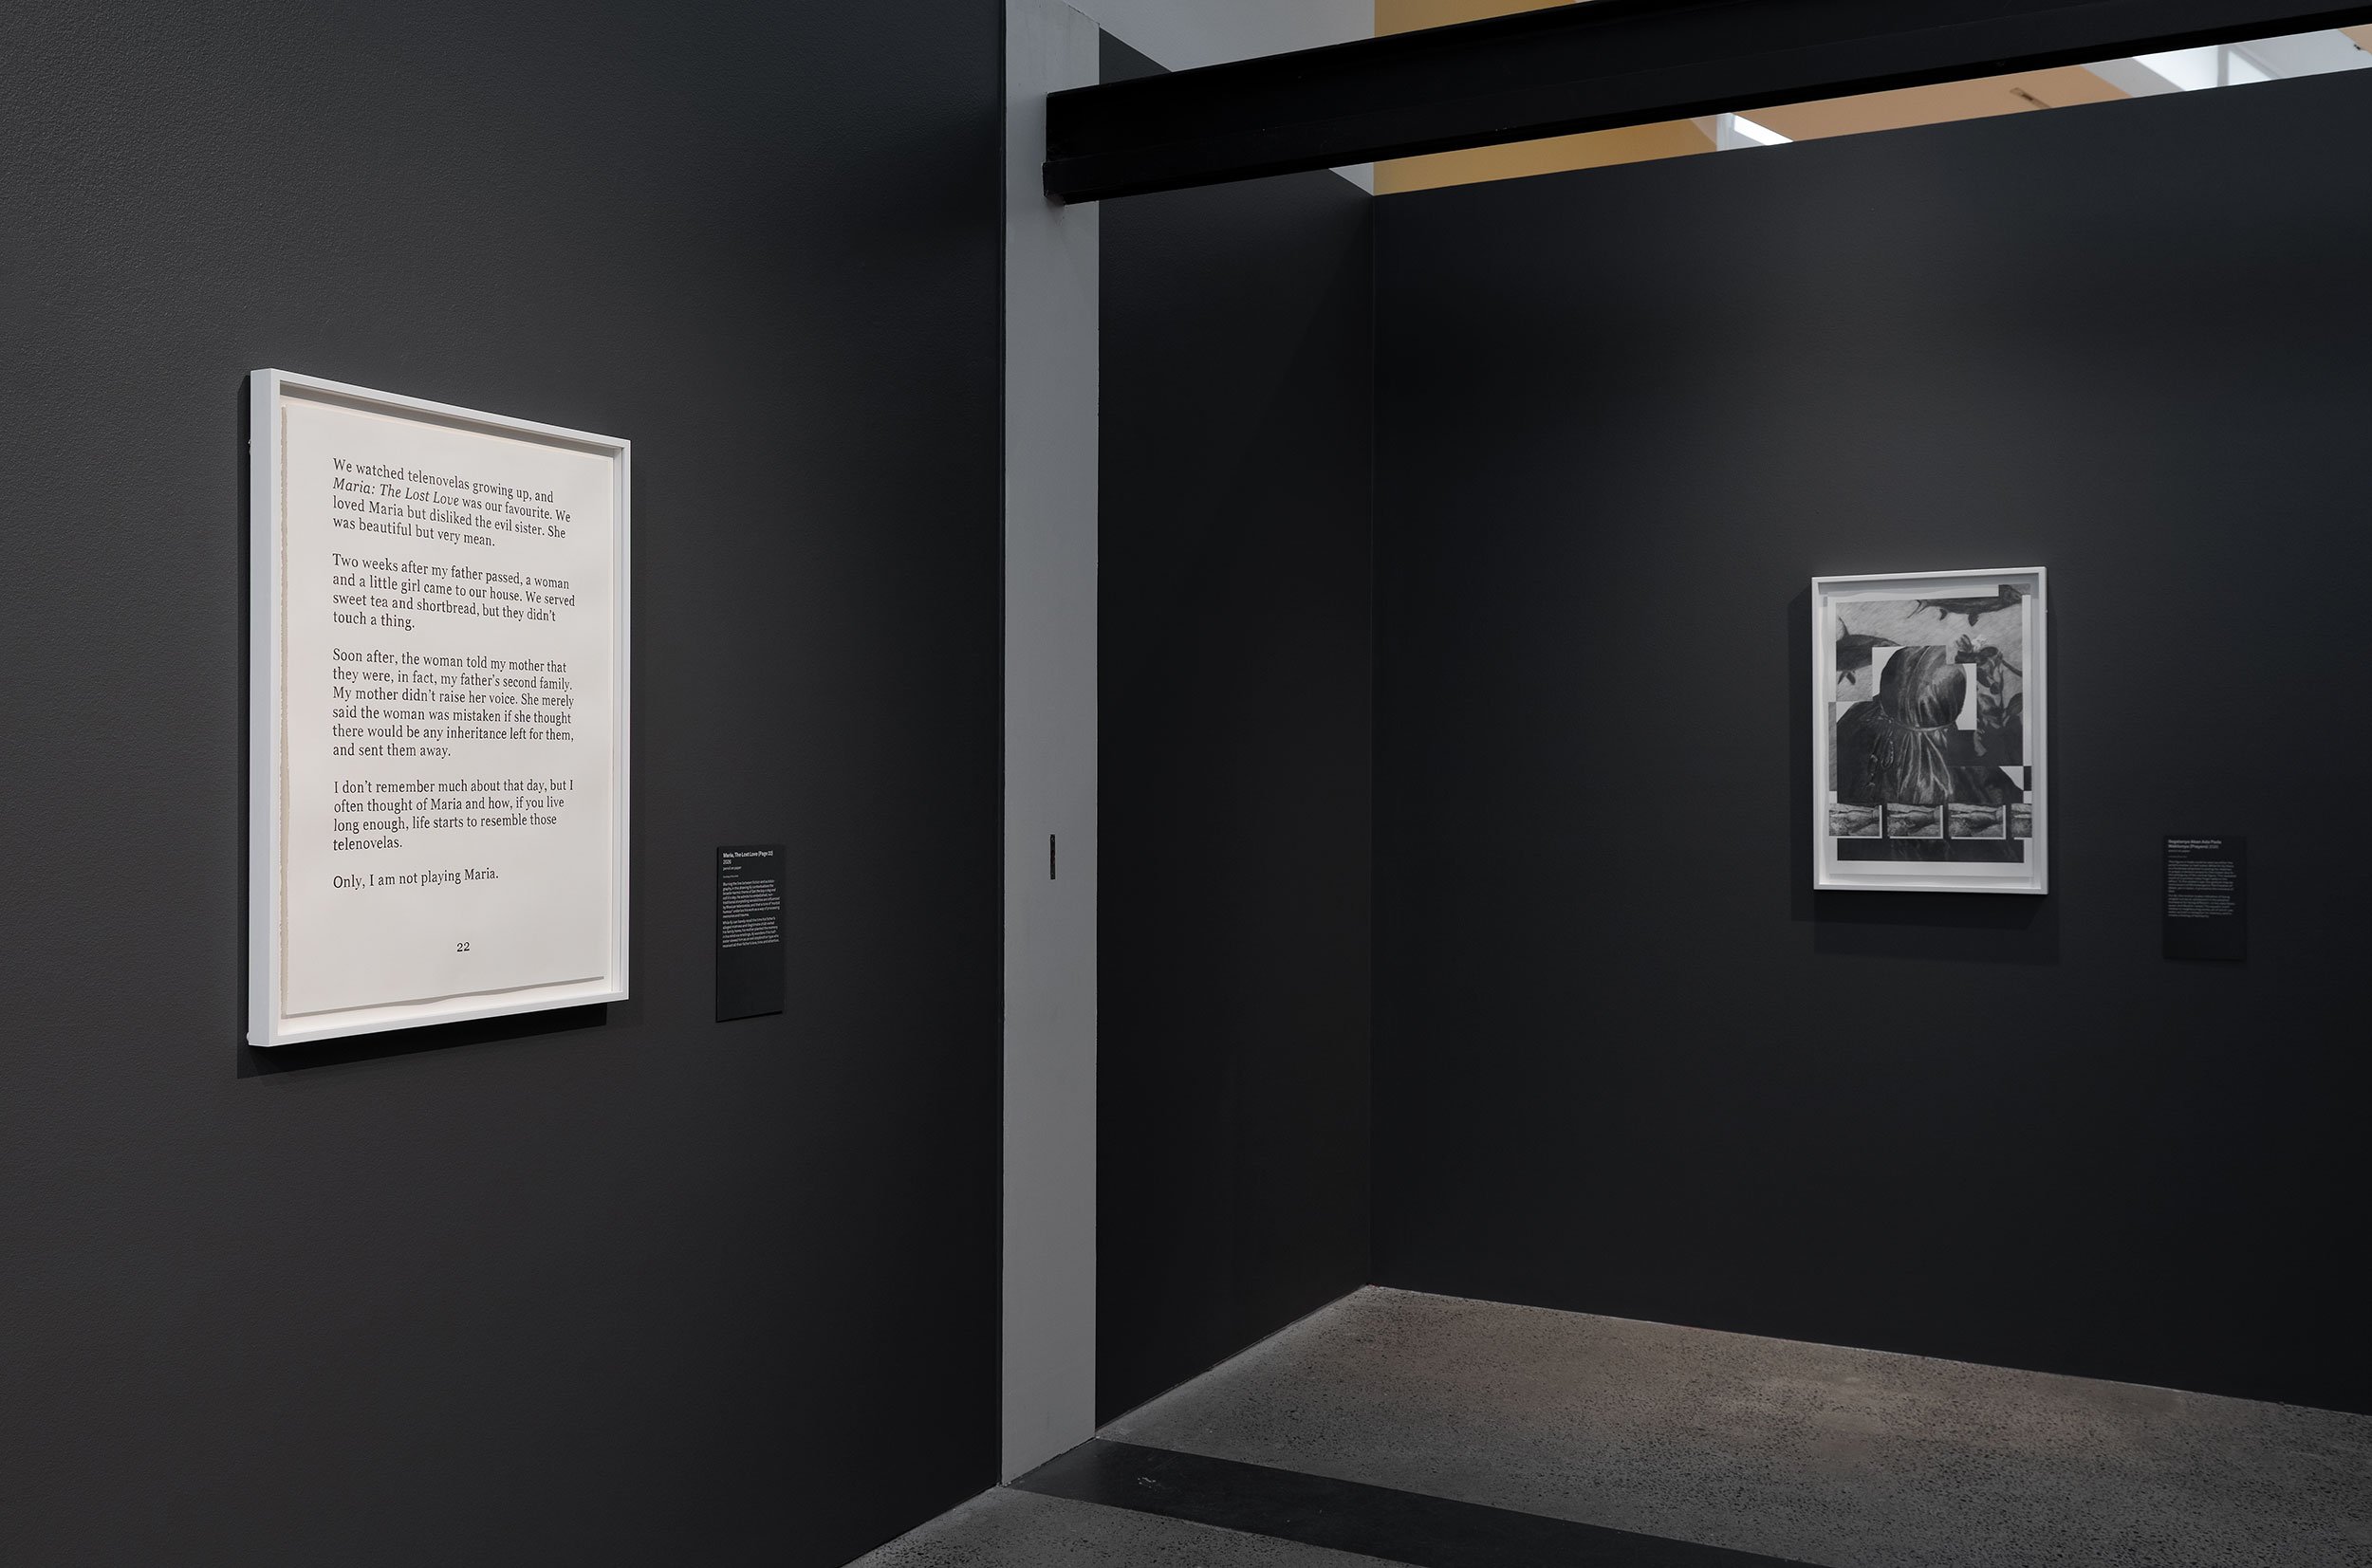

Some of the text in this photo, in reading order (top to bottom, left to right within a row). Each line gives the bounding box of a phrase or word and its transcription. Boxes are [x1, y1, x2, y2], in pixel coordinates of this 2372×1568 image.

[333, 457, 553, 503] We watched telenovelas growing up, and
[332, 477, 570, 523] Maria: The Lost Love was our favourite. We
[333, 495, 565, 539] loved Maria but disliked the evil sister. She
[333, 517, 495, 546] was beautiful but very mean.
[332, 553, 569, 589] Two weeks after my father passed, a woman
[333, 573, 575, 606] and a little girl came to our house. We served
[333, 594, 367, 606] sweet
[370, 595, 388, 608] tea
[392, 597, 414, 610] and
[417, 598, 479, 617] shortbread,
[482, 603, 499, 617] but
[502, 605, 524, 622] they
[333, 611, 415, 631] touch a thing.
[333, 648, 566, 673] Soon after, the woman told my mother that
[332, 666, 359, 684] they
[362, 672, 394, 684] were,
[398, 670, 409, 683] in
[413, 670, 437, 686] fact,
[440, 675, 457, 688] my
[503, 676, 537, 689] second
[540, 676, 572, 692] family.
[333, 686, 352, 702] My
[355, 687, 398, 700] mother
[439, 691, 465, 703] raise
[469, 691, 487, 703] her
[489, 692, 518, 705] voice.
[521, 692, 539, 706] She
[542, 694, 574, 710] merely
[332, 705, 571, 727] said the woman was mistaken if she thought
[332, 723, 574, 742] there would be any inheritance left for them,
[333, 743, 451, 759] and sent them away.
[334, 781, 339, 793] I
[376, 779, 435, 793] remember
[438, 779, 468, 792] much
[471, 779, 500, 792] about
[503, 779, 524, 791] that
[527, 779, 547, 794] day,
[549, 779, 566, 791] but
[569, 780, 573, 790] I
[334, 795, 565, 815] often thought of Maria and how, if you live
[334, 813, 557, 835] long enough, life starts to resemble those
[333, 835, 402, 851] telenovelas.
[333, 867, 498, 891] Only, I am not playing Maria.
[456, 942, 470, 952] 22
